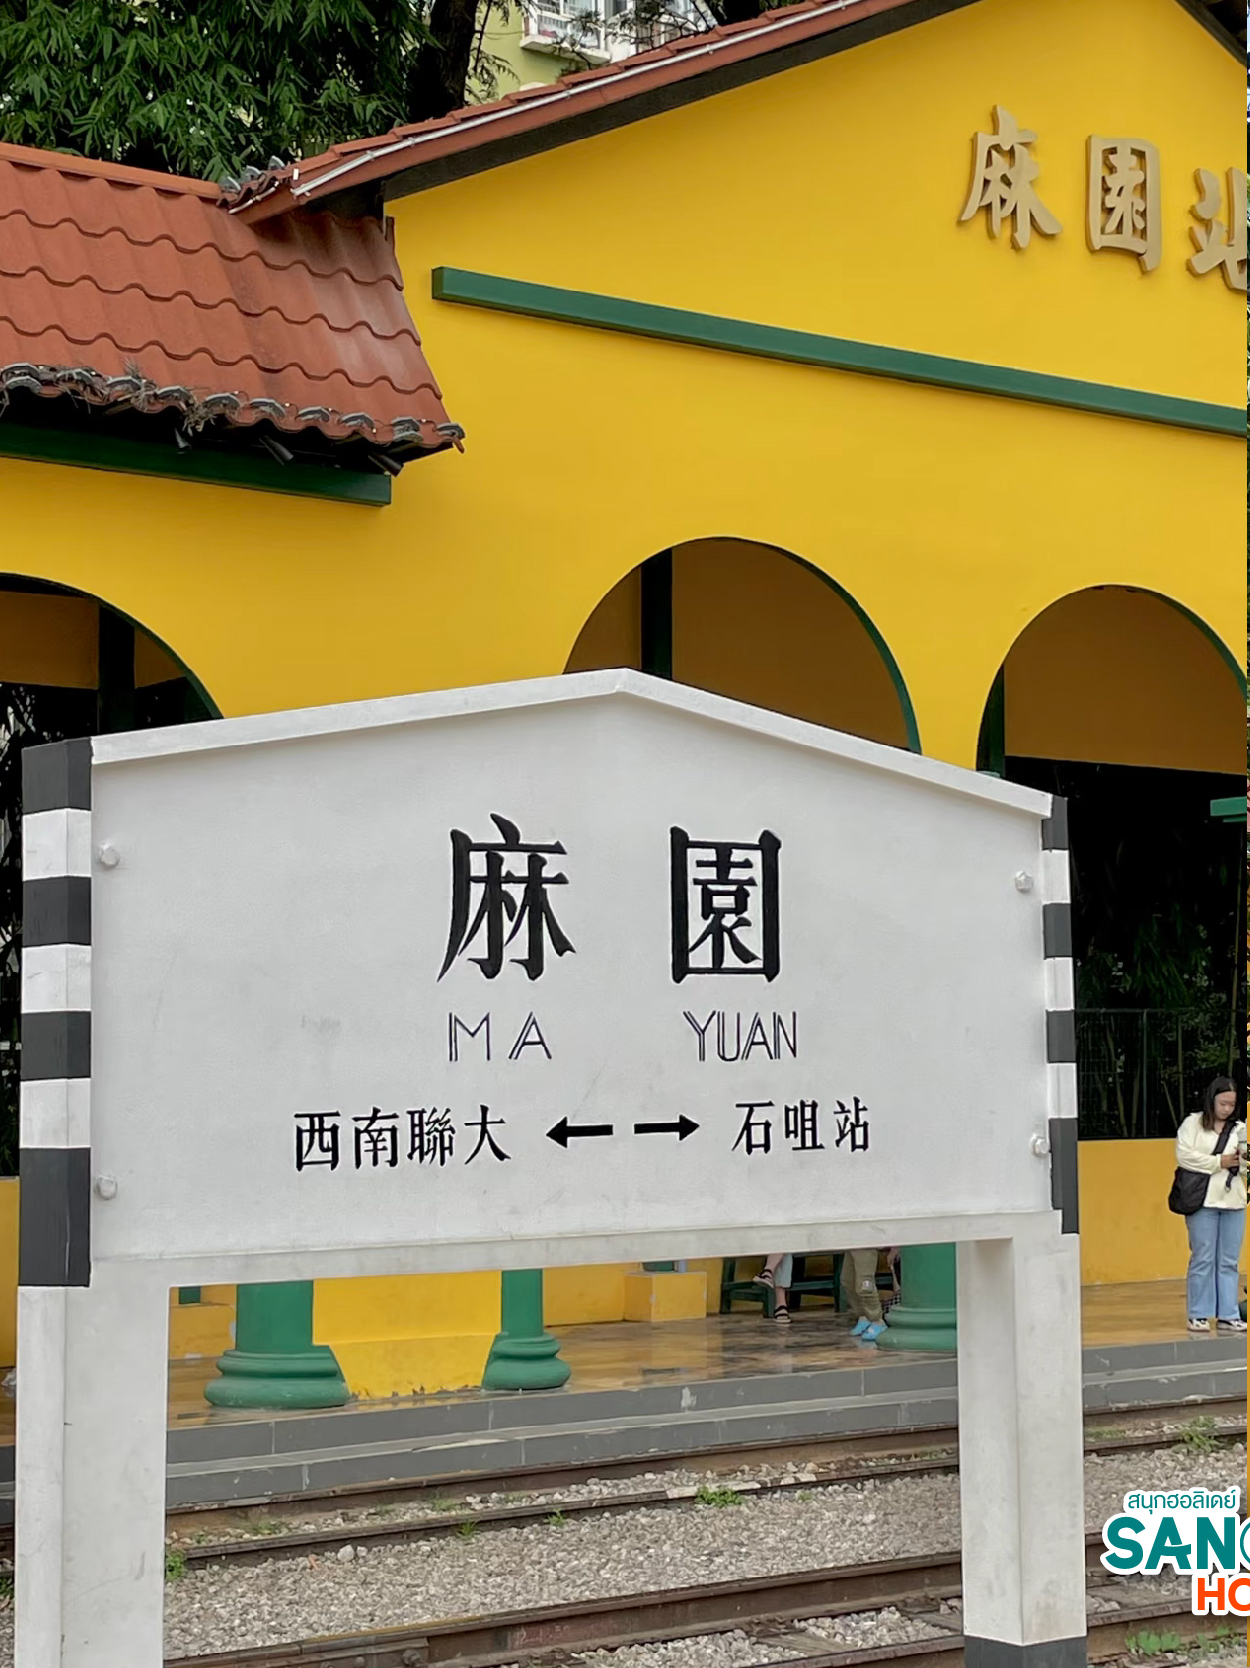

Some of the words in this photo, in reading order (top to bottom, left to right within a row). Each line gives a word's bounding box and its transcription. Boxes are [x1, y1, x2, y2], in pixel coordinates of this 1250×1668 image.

[437, 813, 782, 983] 麻園
[448, 1011, 552, 1063] MA
[683, 1010, 798, 1062] YUAN
[294, 1104, 511, 1172] 西南聯大
[731, 1096, 871, 1156] 石咀站
